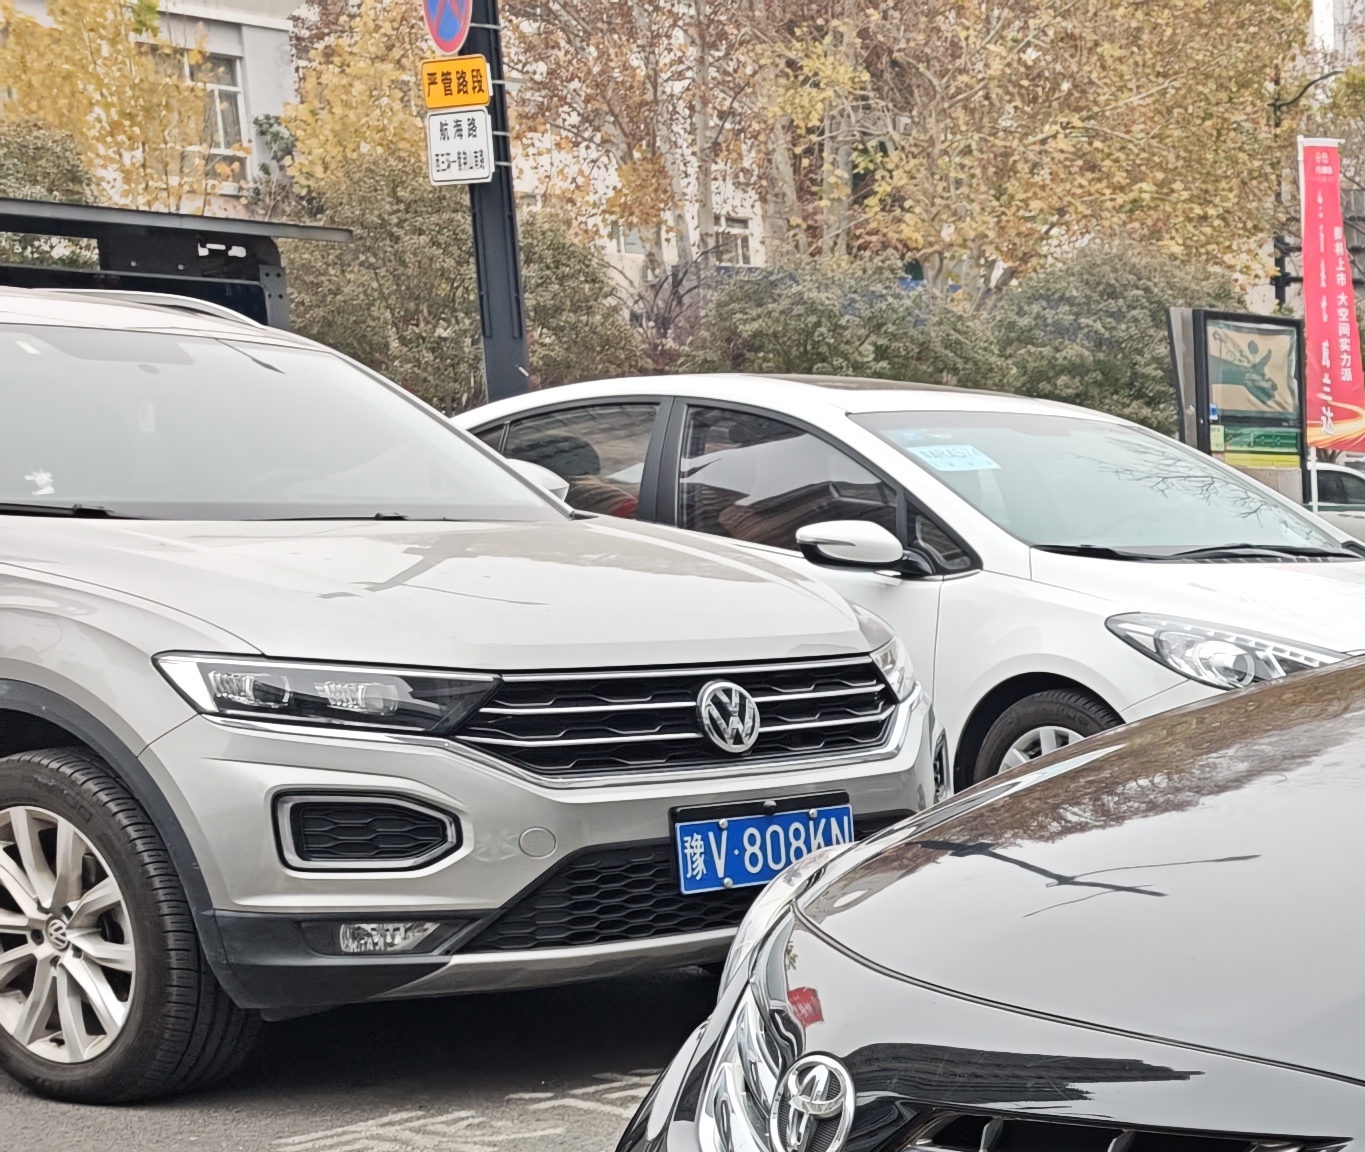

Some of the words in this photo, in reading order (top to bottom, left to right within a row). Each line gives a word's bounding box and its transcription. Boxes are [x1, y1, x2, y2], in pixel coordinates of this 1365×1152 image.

[427, 69, 485, 97] 严管路段
[439, 117, 477, 141] 航海路
